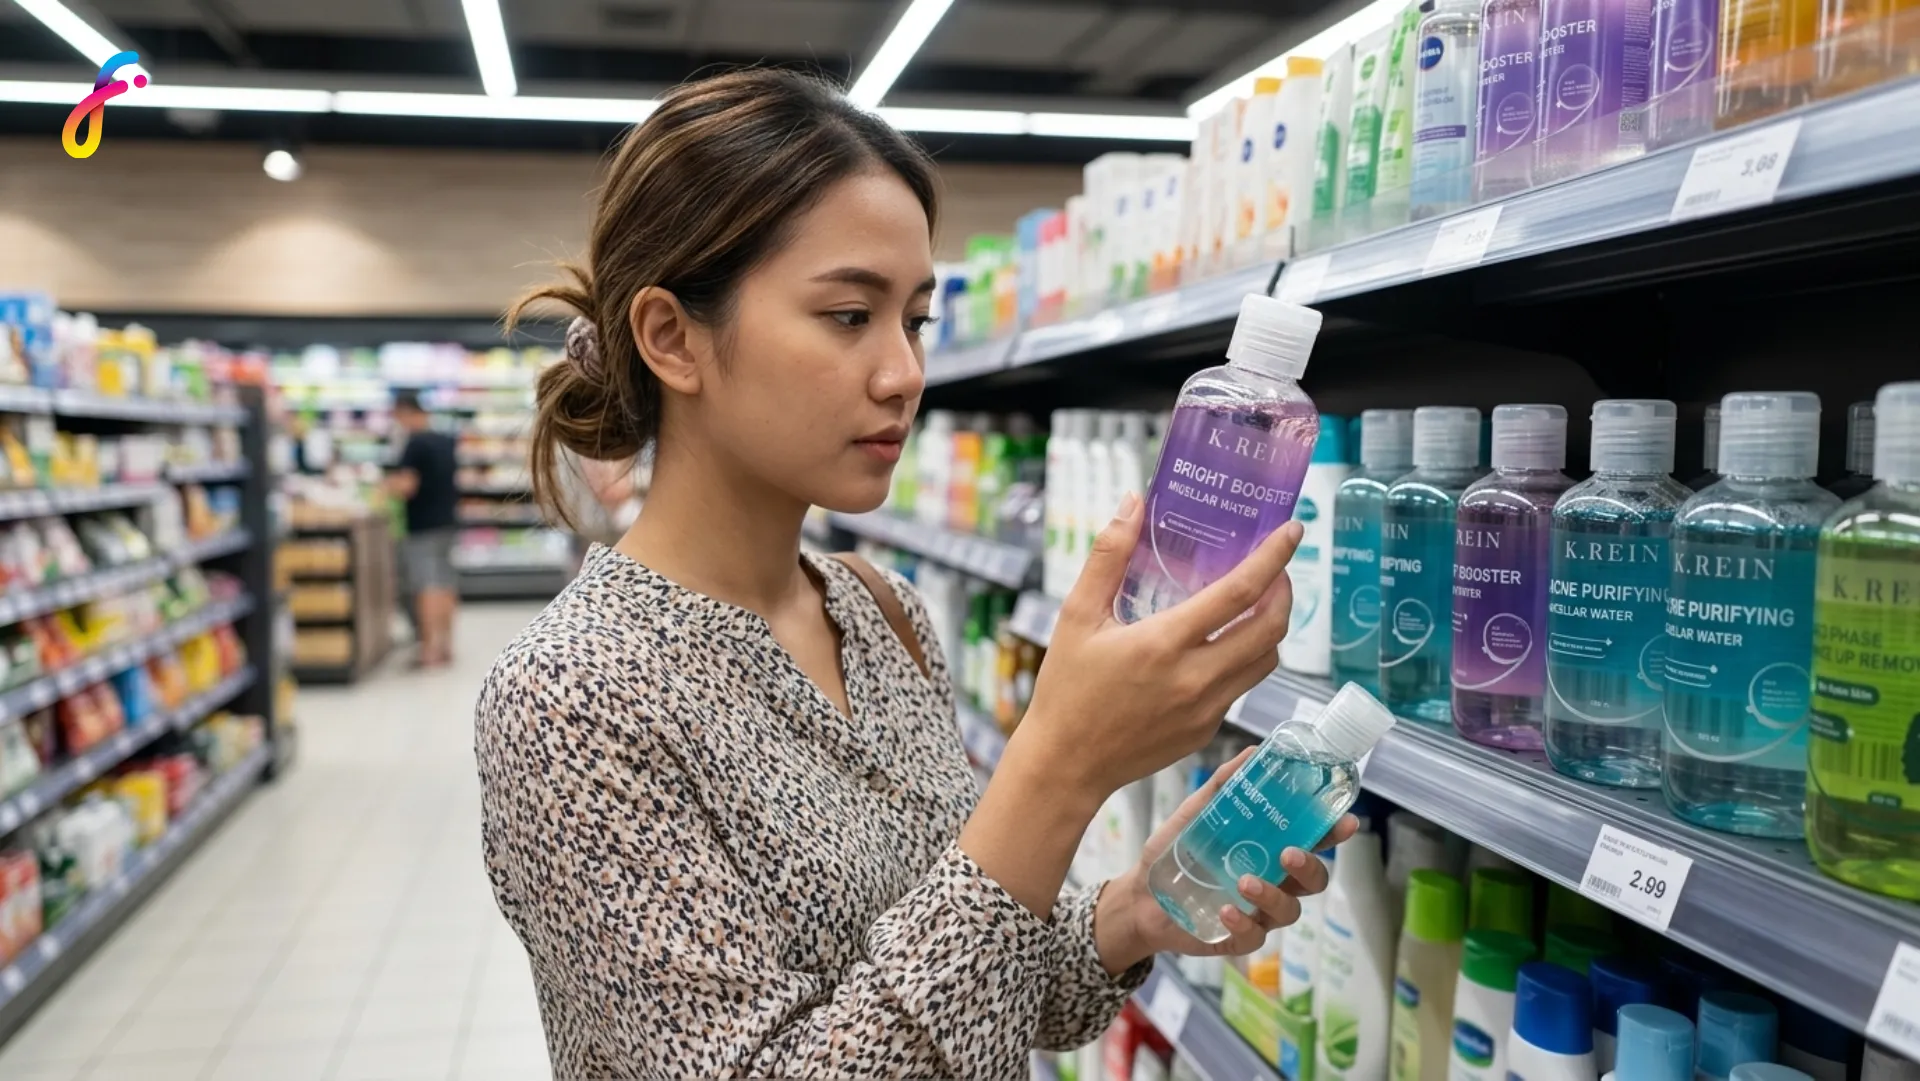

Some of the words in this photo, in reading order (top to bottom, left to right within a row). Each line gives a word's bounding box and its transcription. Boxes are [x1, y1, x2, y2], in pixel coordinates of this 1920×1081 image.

[1539, 19, 1596, 45] OOSTER
[1480, 51, 1533, 72] OOSTER
[1208, 427, 1292, 467] K.REIN
[1173, 457, 1229, 490] BRIGHT
[1230, 478, 1294, 506] BOOSTER
[1565, 540, 1660, 563] K.REIN
[1673, 552, 1775, 580] K.REIN
[1833, 574, 1920, 605] K.RE
[1590, 608, 1633, 621] WATER
[1688, 601, 1795, 627] PURIFYING
[1696, 629, 1743, 647] WATER
[1830, 626, 1882, 649] PHASE
[1629, 870, 1667, 899] 2.99
